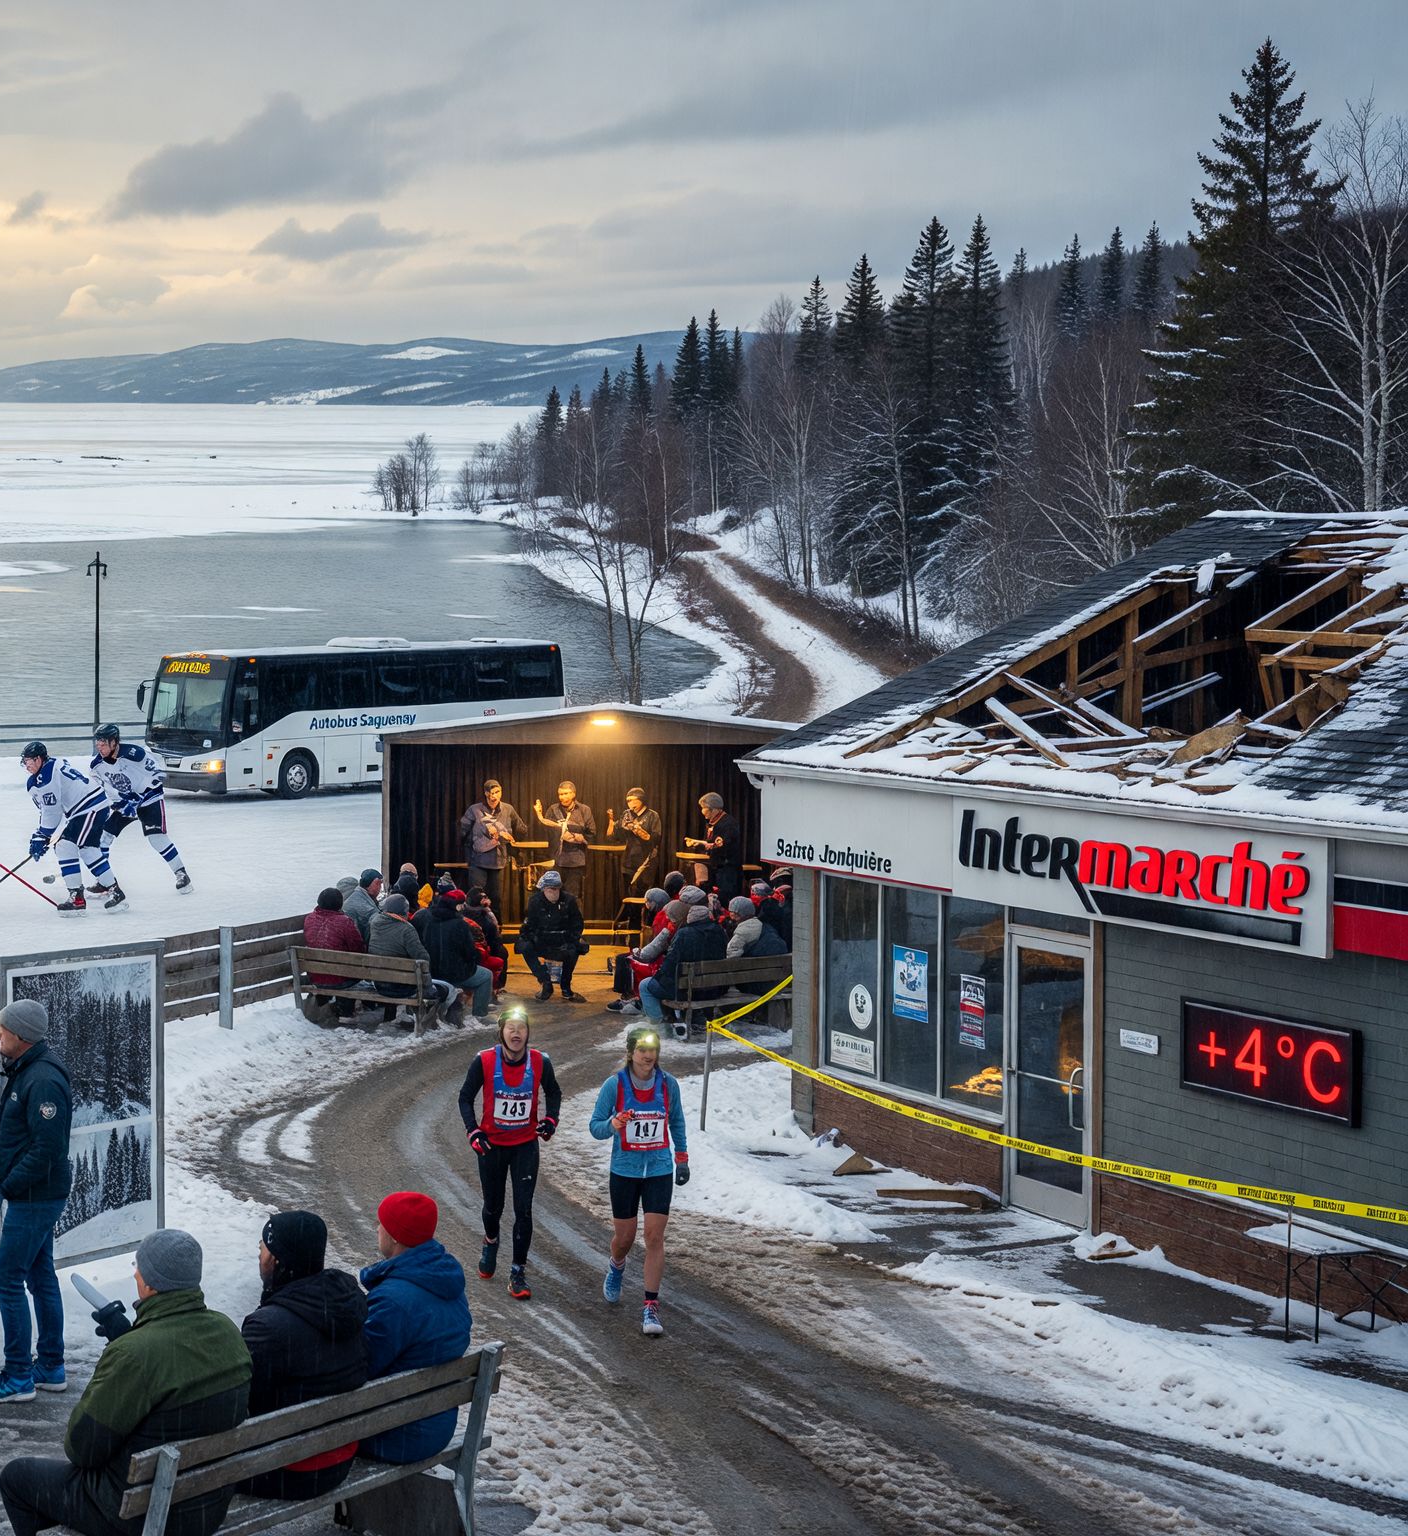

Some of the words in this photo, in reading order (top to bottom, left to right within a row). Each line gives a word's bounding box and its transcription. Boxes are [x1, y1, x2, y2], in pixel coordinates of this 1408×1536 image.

[309, 714, 358, 731] Autobus
[958, 809, 1311, 917] Intermarché
[1198, 1027, 1342, 1104] +4°C
